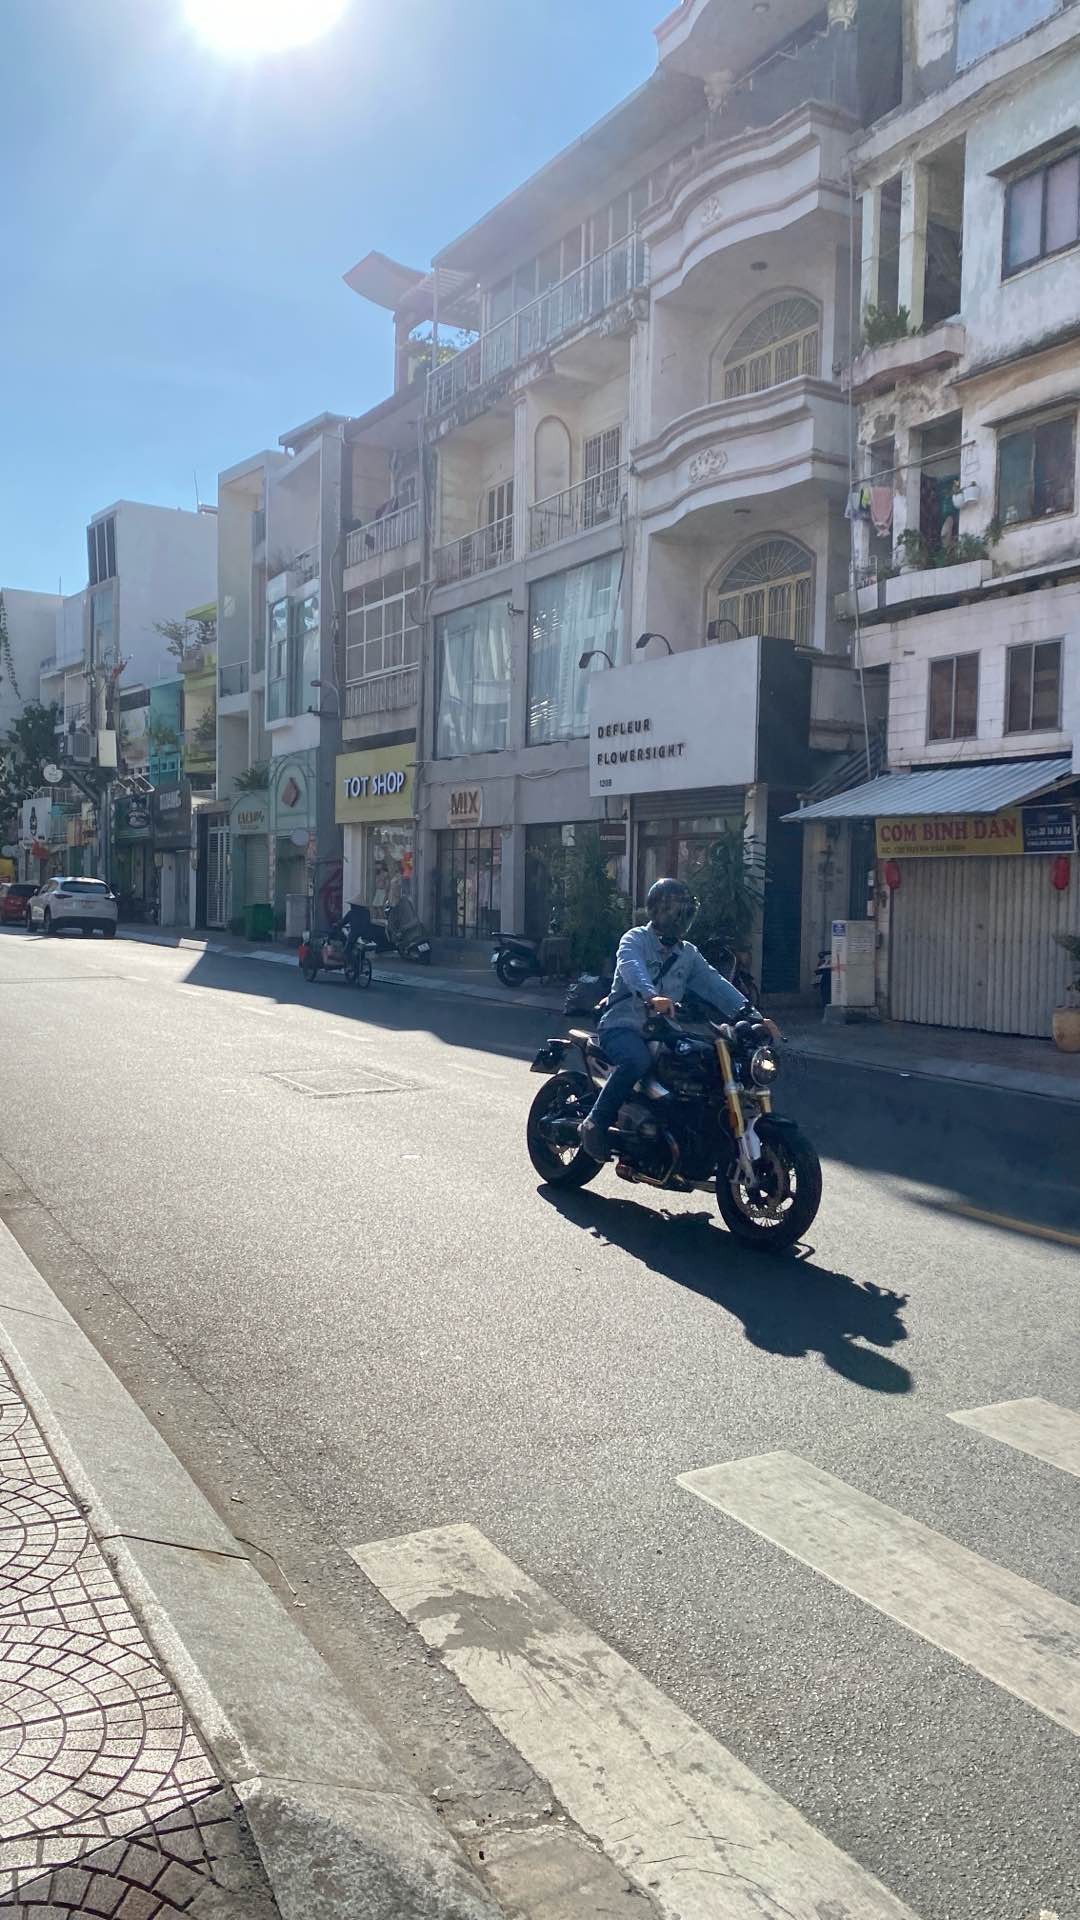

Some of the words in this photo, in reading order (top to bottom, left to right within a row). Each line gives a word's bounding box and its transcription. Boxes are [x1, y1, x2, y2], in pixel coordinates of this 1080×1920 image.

[598, 718, 650, 738] DEFLEUR
[597, 742, 684, 765] FLOWERSIGHT
[372, 771, 405, 796] SHOP
[450, 791, 478, 815] MIX
